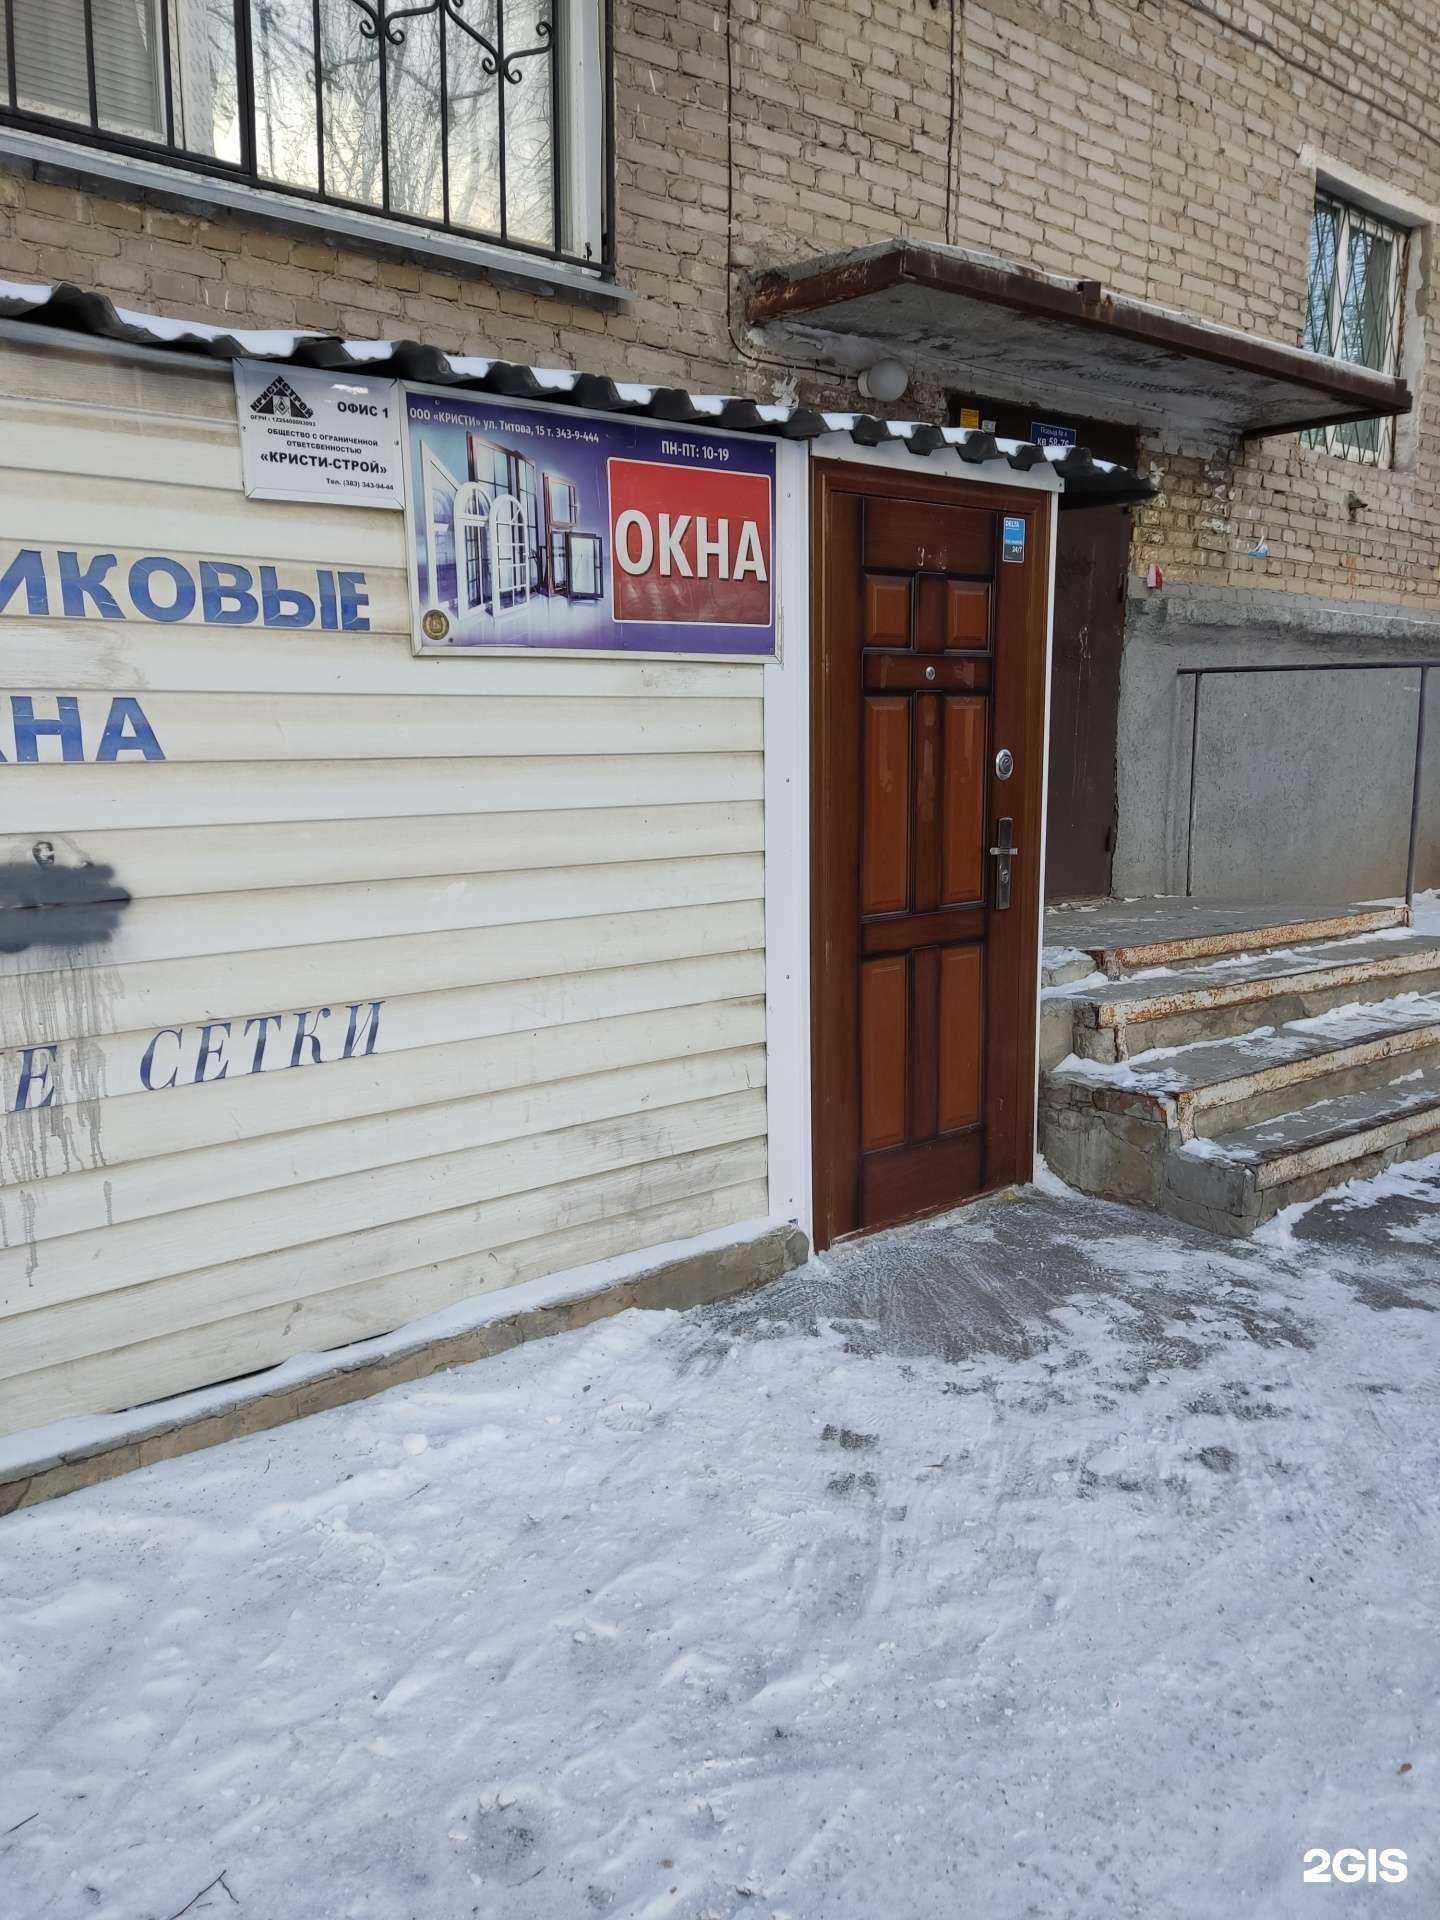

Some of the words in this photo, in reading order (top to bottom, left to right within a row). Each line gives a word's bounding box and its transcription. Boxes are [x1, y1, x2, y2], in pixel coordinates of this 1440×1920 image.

[250, 376, 285, 412] КРИСТИ
[281, 382, 314, 418] СТРОЙ
[337, 401, 378, 417] ОФИС
[382, 407, 389, 418] 1
[267, 427, 311, 440] ОБЩЕСТВО
[319, 434, 379, 447] ОГРАНИЧЕННОЙ
[409, 407, 431, 421] ООО
[433, 410, 481, 427] «КРИСТИ»
[483, 419, 498, 431] ул.
[500, 420, 534, 436] Титова,
[535, 425, 545, 436] 15
[547, 428, 554, 437] т.
[556, 427, 600, 443] 343-9-444
[260, 451, 387, 474] «КРИСТИ-СТРОЙ»
[661, 439, 700, 459] ПН-ПТ:
[702, 445, 730, 462] 10-19
[615, 509, 768, 582] ОКНА
[0, 695, 167, 762] НА
[139, 1000, 387, 1092] СЕТКИ
